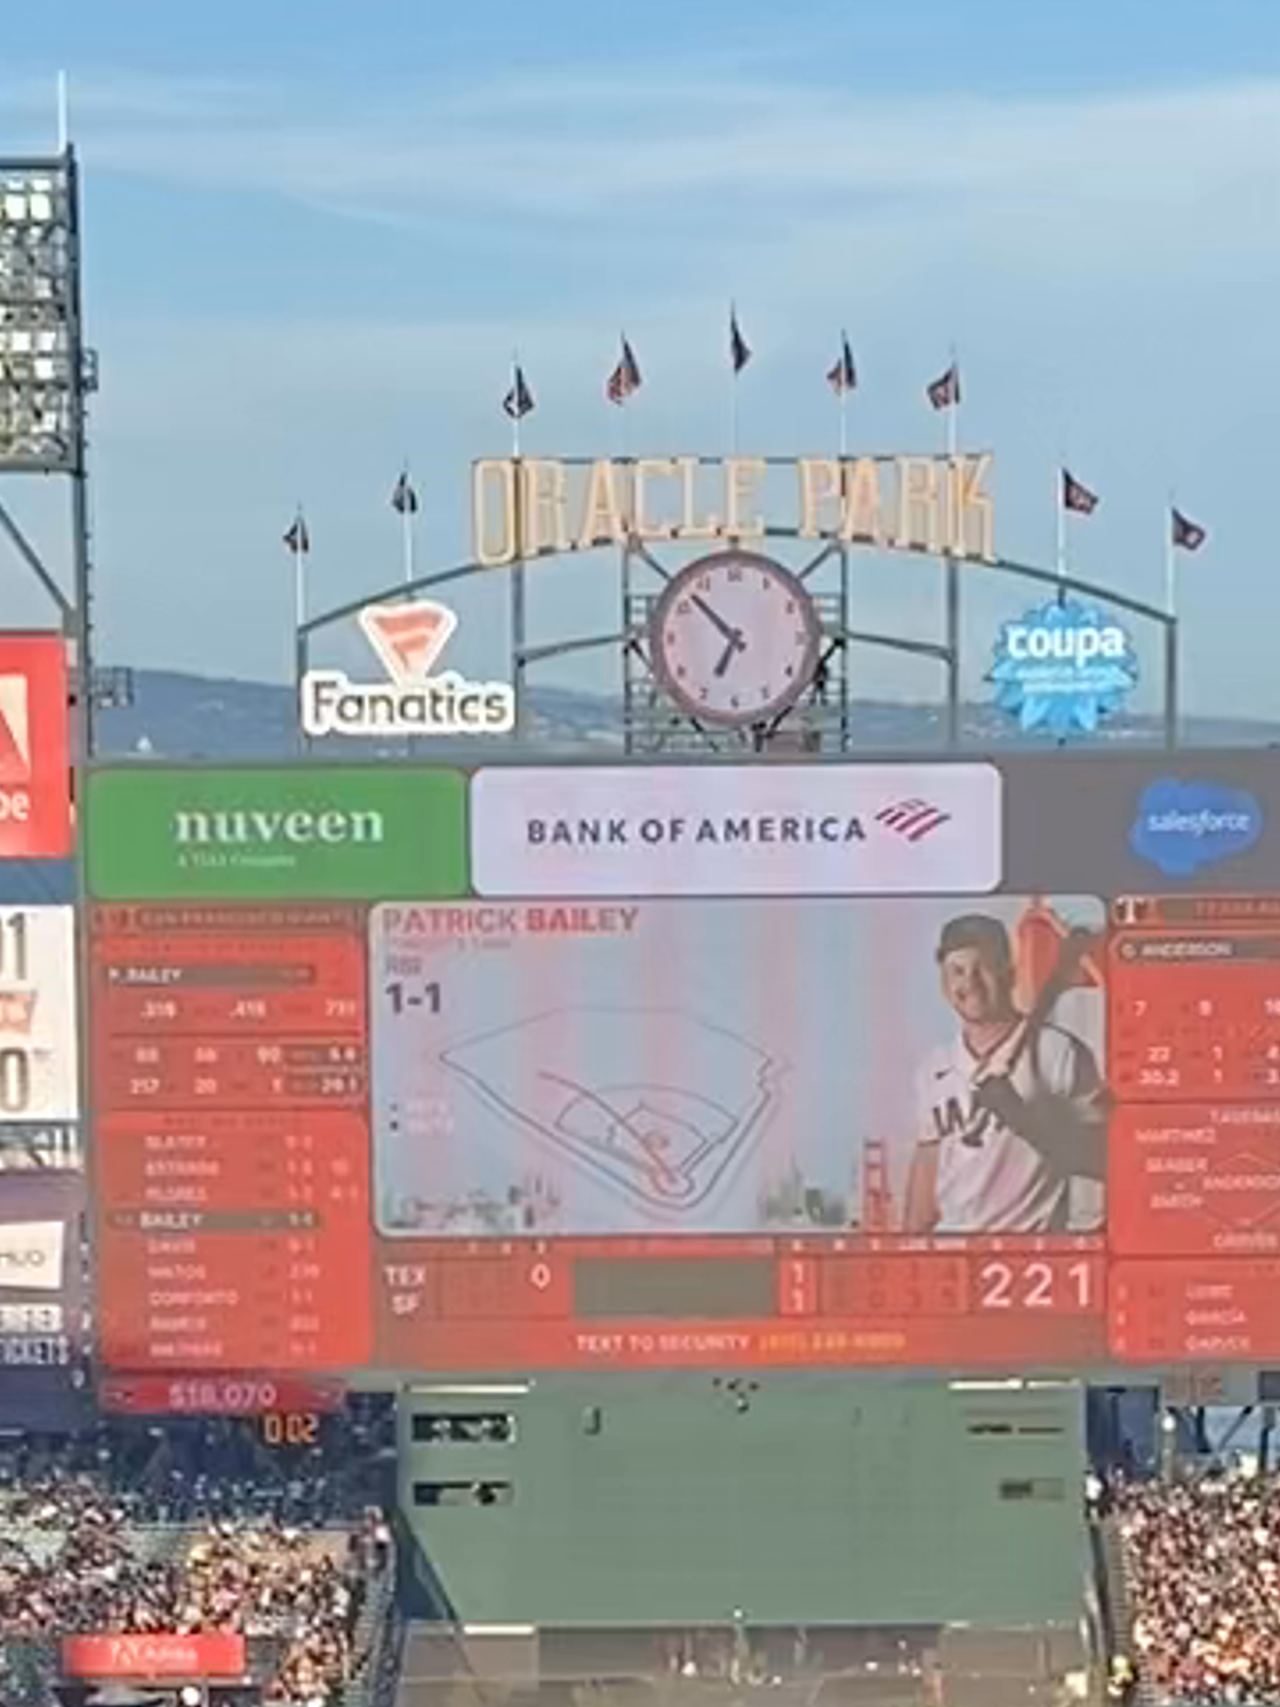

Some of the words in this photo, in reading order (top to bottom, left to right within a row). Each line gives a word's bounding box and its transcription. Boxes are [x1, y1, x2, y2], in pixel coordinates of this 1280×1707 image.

[472, 456, 767, 566] ORACLE
[797, 453, 997, 563] PARK
[1008, 627, 1125, 667] coupa
[313, 679, 507, 725] Fanatics
[176, 809, 383, 842] nuveen
[527, 819, 629, 844] BANK
[639, 818, 687, 843] OF
[695, 816, 867, 843] AMERICA
[1148, 809, 1249, 837] salesforce
[382, 908, 517, 931] PATRICK
[526, 908, 640, 931] BAILEY
[385, 982, 441, 1013] 1-1
[385, 1265, 427, 1286] TEX
[530, 1262, 551, 1289] 0
[392, 1295, 419, 1314] SF
